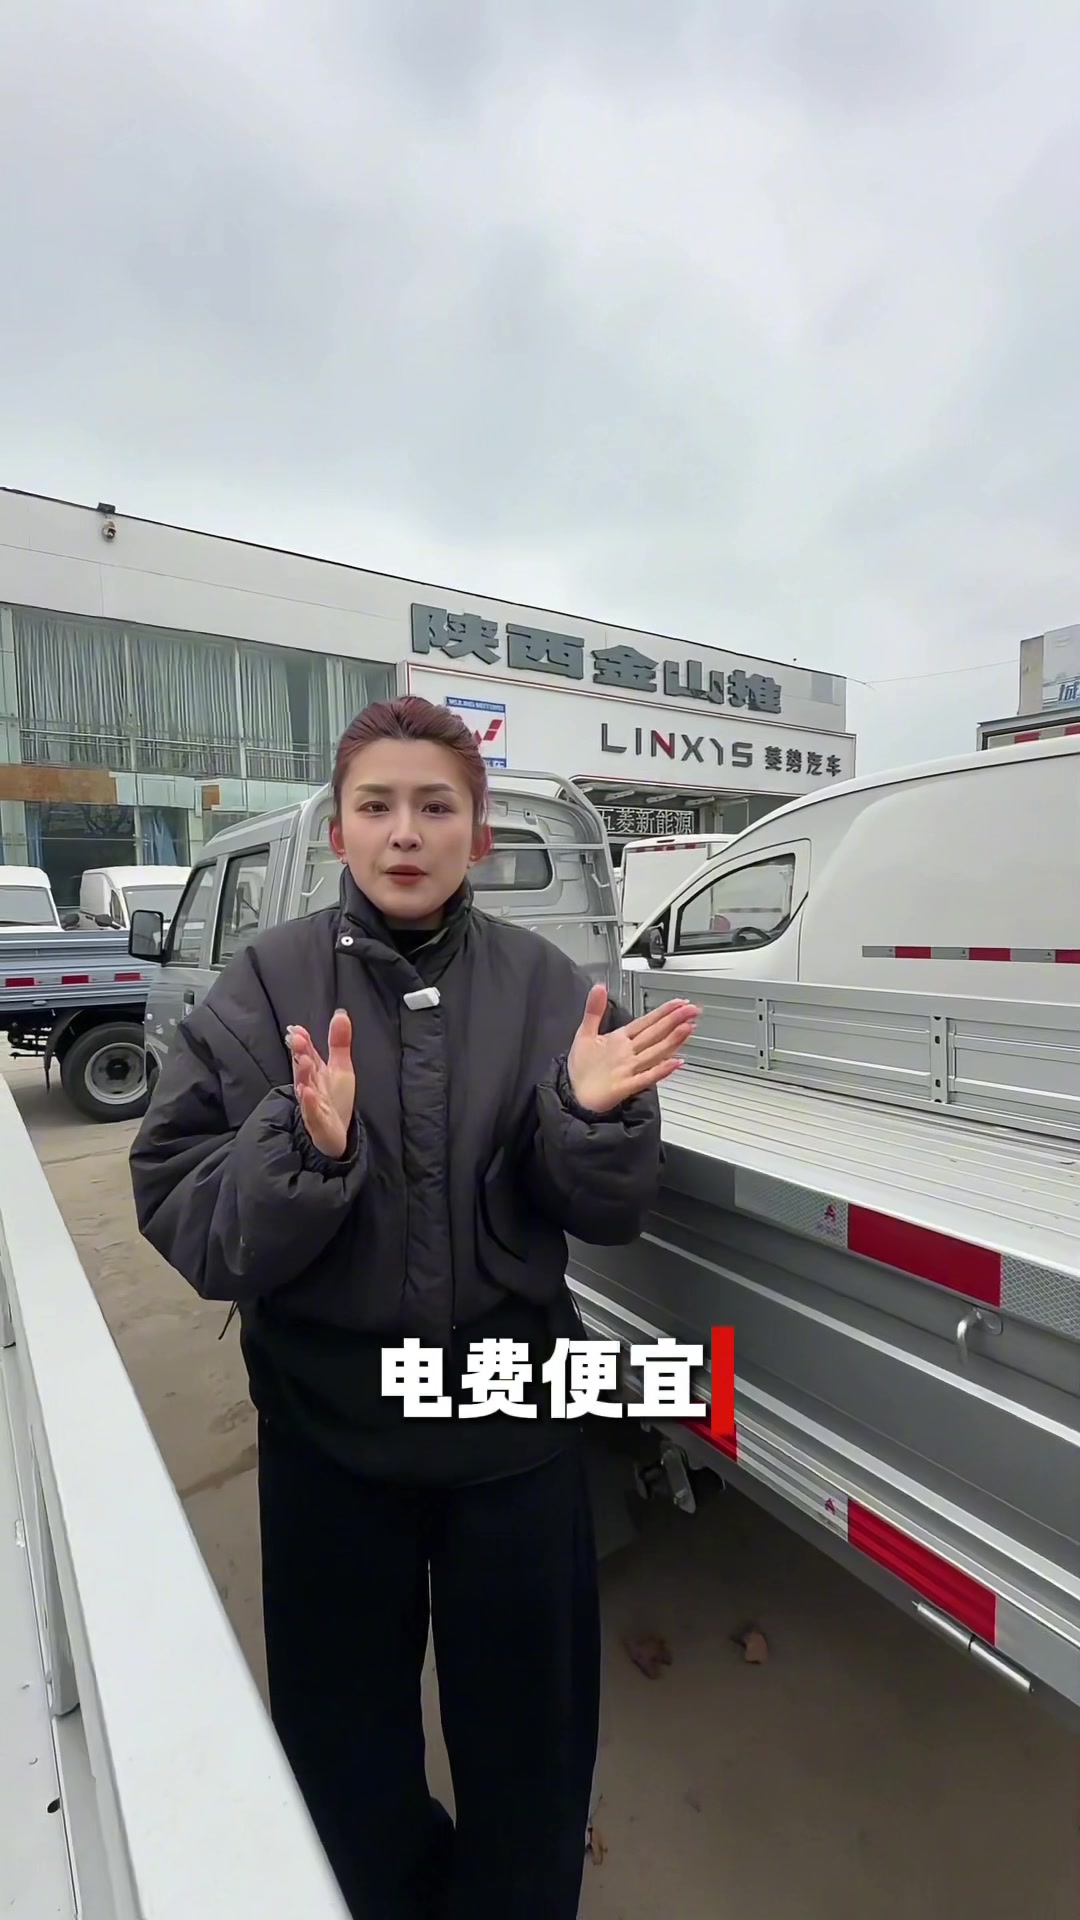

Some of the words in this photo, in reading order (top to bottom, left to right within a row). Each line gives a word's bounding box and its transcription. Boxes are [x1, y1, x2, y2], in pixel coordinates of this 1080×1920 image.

[411, 603, 782, 714] 陕西金山推
[601, 723, 753, 768] LINXYS
[764, 745, 842, 777] 菱势汽车
[597, 807, 693, 835] 五菱新能源
